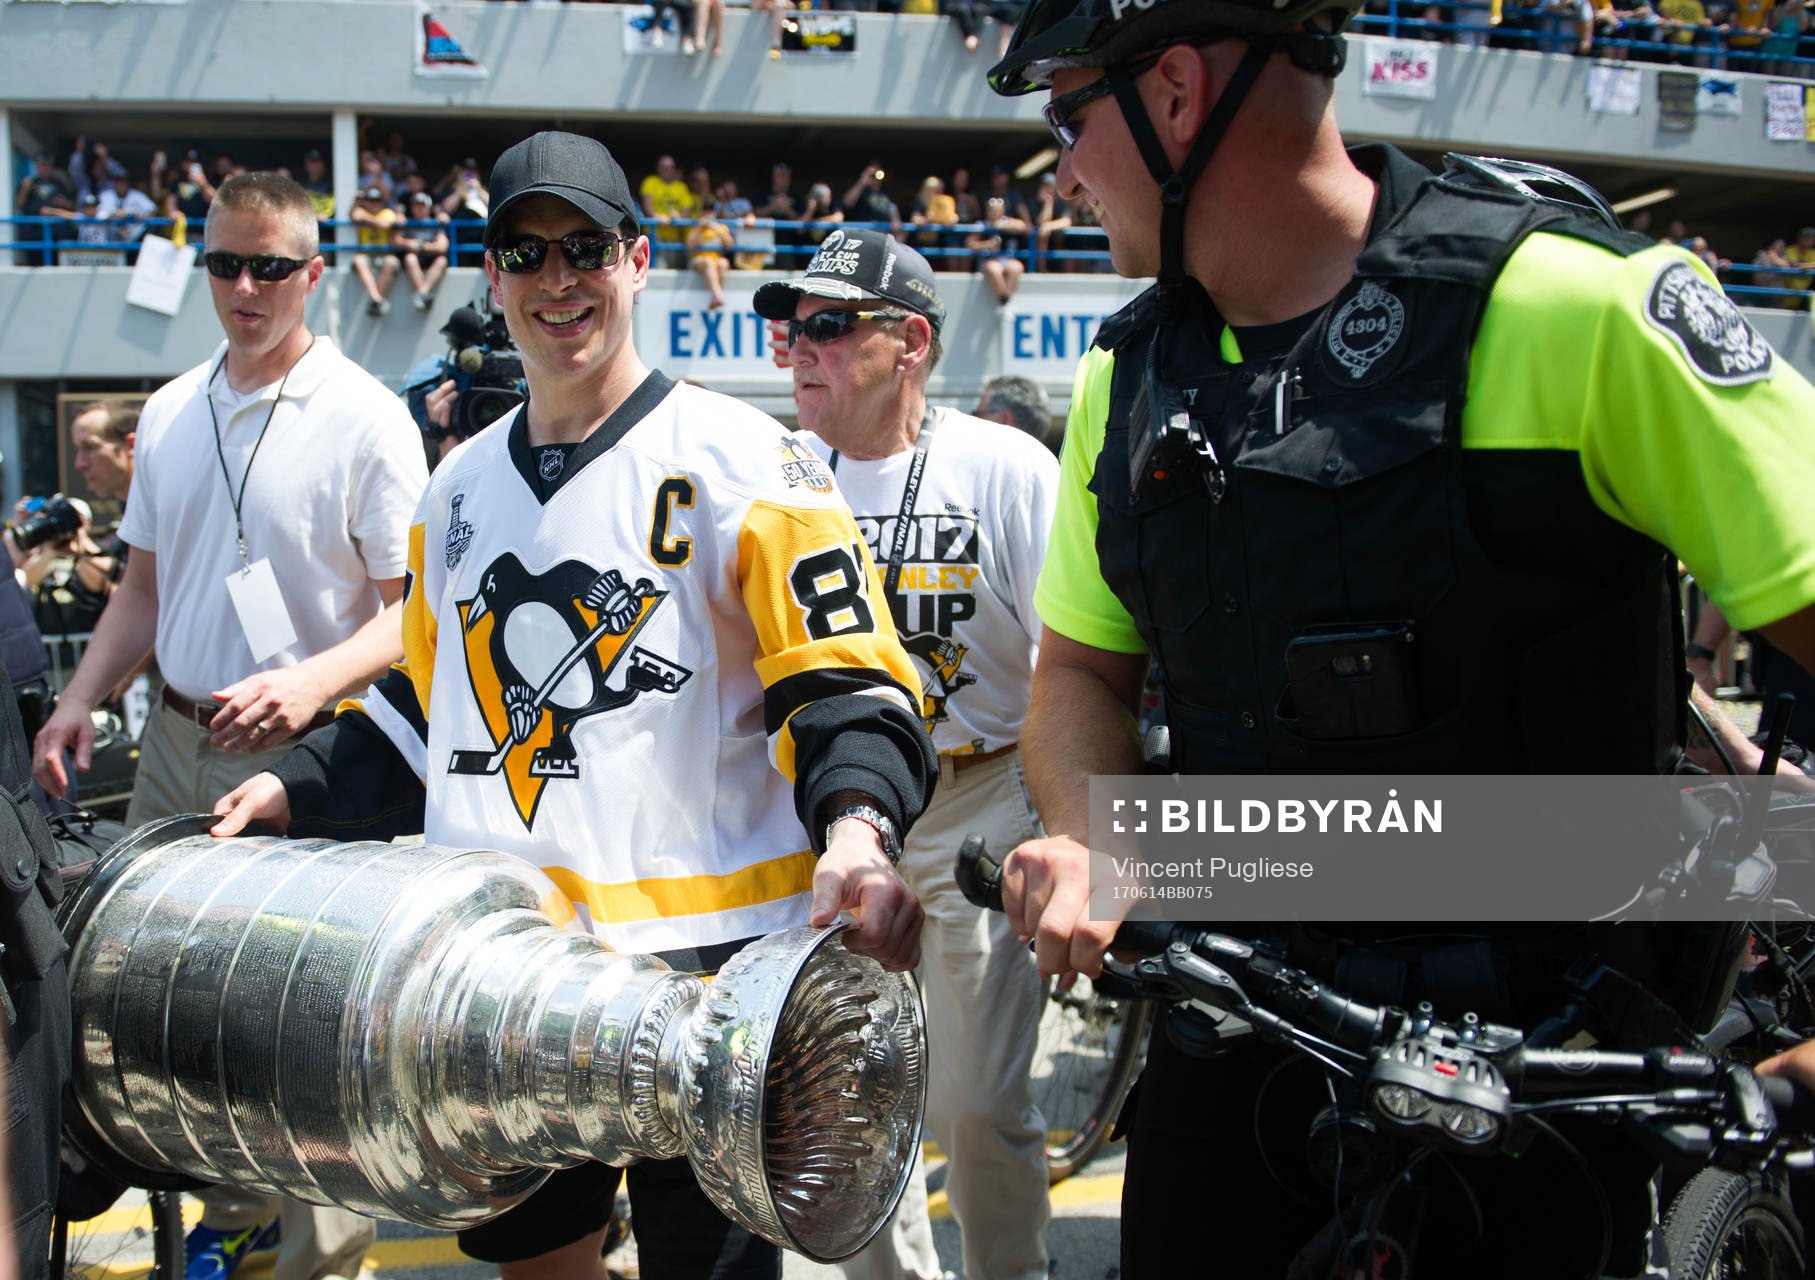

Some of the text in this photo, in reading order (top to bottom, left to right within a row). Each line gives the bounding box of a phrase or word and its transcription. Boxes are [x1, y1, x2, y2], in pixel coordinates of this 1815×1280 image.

[1371, 60, 1428, 80] KISS
[836, 250, 860, 260] CUP
[879, 252, 897, 290] Reebok
[670, 311, 763, 358] EXIT
[1014, 314, 1109, 359] ENT
[1345, 316, 1388, 336] 4304
[1390, 300, 1407, 346] POLICE
[543, 457, 560, 474] NHL
[782, 462, 806, 481] 50
[908, 447, 926, 493] STANLEY
[903, 491, 915, 514] CUP
[648, 476, 697, 569] C
[894, 514, 909, 552] FINAL
[786, 541, 877, 641] 8
[893, 593, 977, 638] UP
